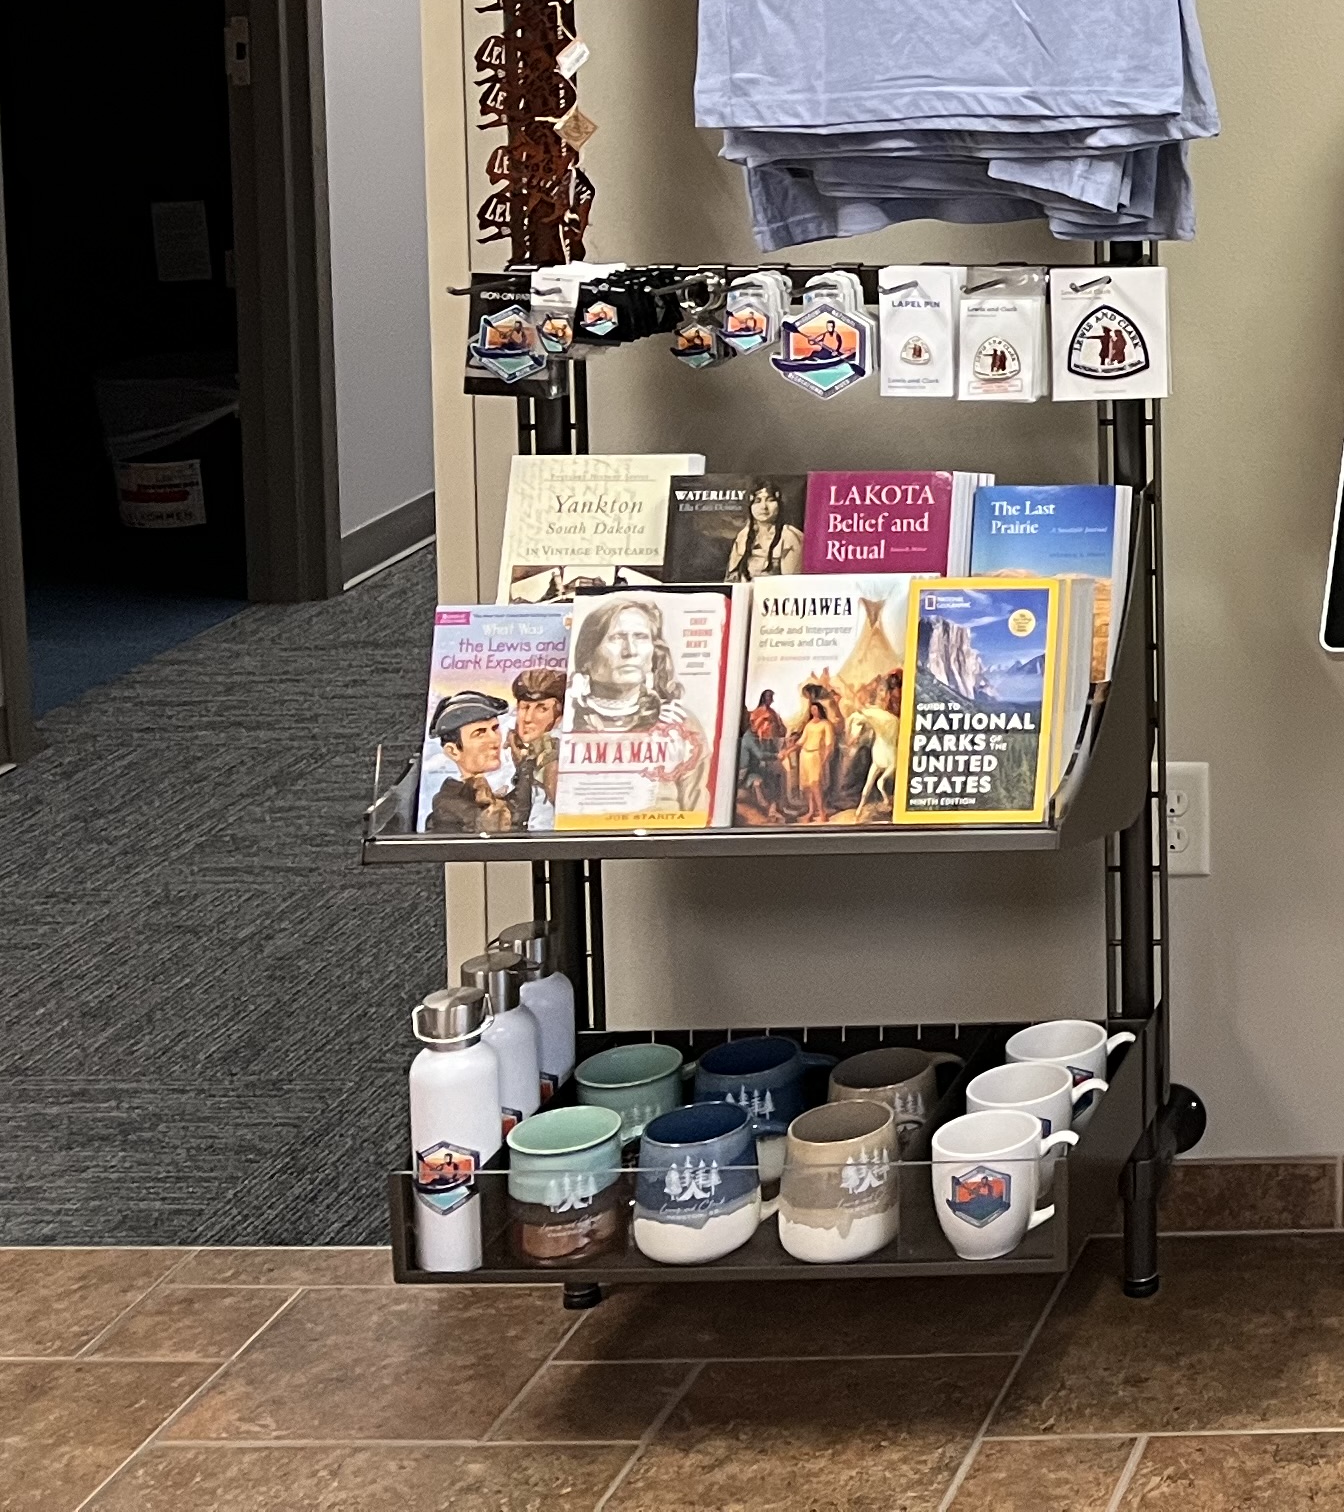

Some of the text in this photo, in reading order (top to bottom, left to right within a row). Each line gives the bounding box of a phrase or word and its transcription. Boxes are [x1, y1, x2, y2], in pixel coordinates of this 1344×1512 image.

[891, 300, 940, 309] LAPEL PIN
[967, 306, 986, 314] Lewis
[1072, 310, 1142, 352] LEWIS AND CLARK
[888, 377, 907, 385] Lewis
[922, 377, 940, 385] Clark
[674, 490, 746, 501] WATERLILY
[828, 484, 936, 506] LAKOTA
[554, 493, 644, 517] Yankton
[991, 501, 1056, 516] The Last
[545, 521, 646, 536] South Dakota
[826, 512, 930, 533] Belief and
[990, 519, 1040, 536] Prairie
[525, 545, 660, 557] IN VINTAGE POSTCARDS
[825, 539, 886, 563] Ritual
[760, 595, 853, 620] SACAJAWEA
[481, 621, 544, 637] What Was
[759, 625, 853, 637] Guide and Interpreter
[458, 637, 567, 653] the Lewis and
[758, 637, 838, 649] of Lewis and Clark
[439, 653, 568, 673] Clark Expedition
[916, 702, 961, 711] GUIDE TO
[914, 712, 1036, 731] NATIONAL
[913, 733, 1007, 752] PARKS OF THE
[581, 740, 624, 764] AM A
[911, 754, 999, 773] UNITED
[909, 775, 992, 795] STATES
[909, 797, 977, 806] NINTH EDITION
[604, 813, 686, 822] JOE STARITA
